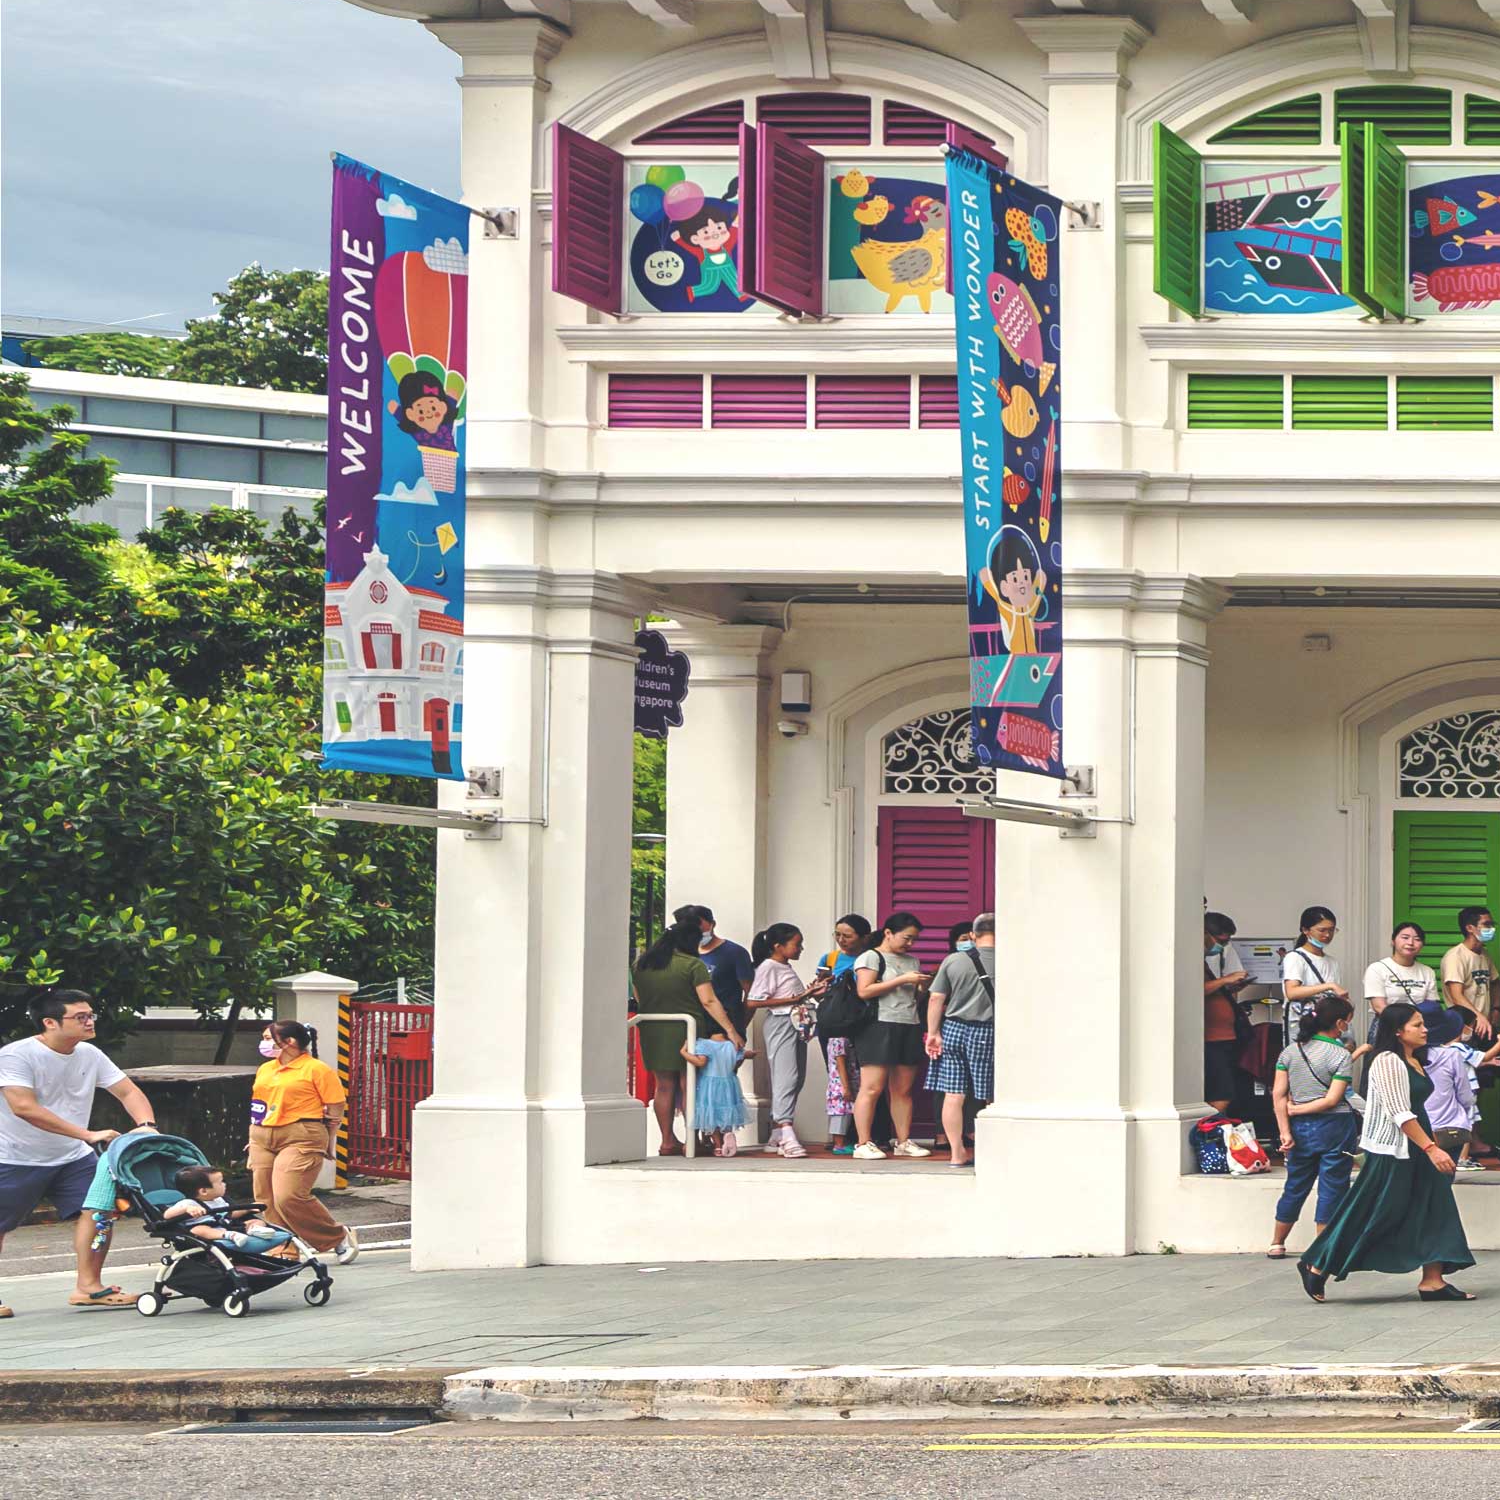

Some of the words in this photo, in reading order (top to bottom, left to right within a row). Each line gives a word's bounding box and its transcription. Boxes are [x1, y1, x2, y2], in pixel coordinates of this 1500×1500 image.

[650, 257, 680, 268] Let's
[656, 270, 672, 279] Go
[961, 189, 982, 321] WONDER
[341, 229, 375, 475] WELCOME
[968, 335, 987, 418] WITH
[971, 432, 991, 530] START
[634, 694, 673, 709] ngapore
